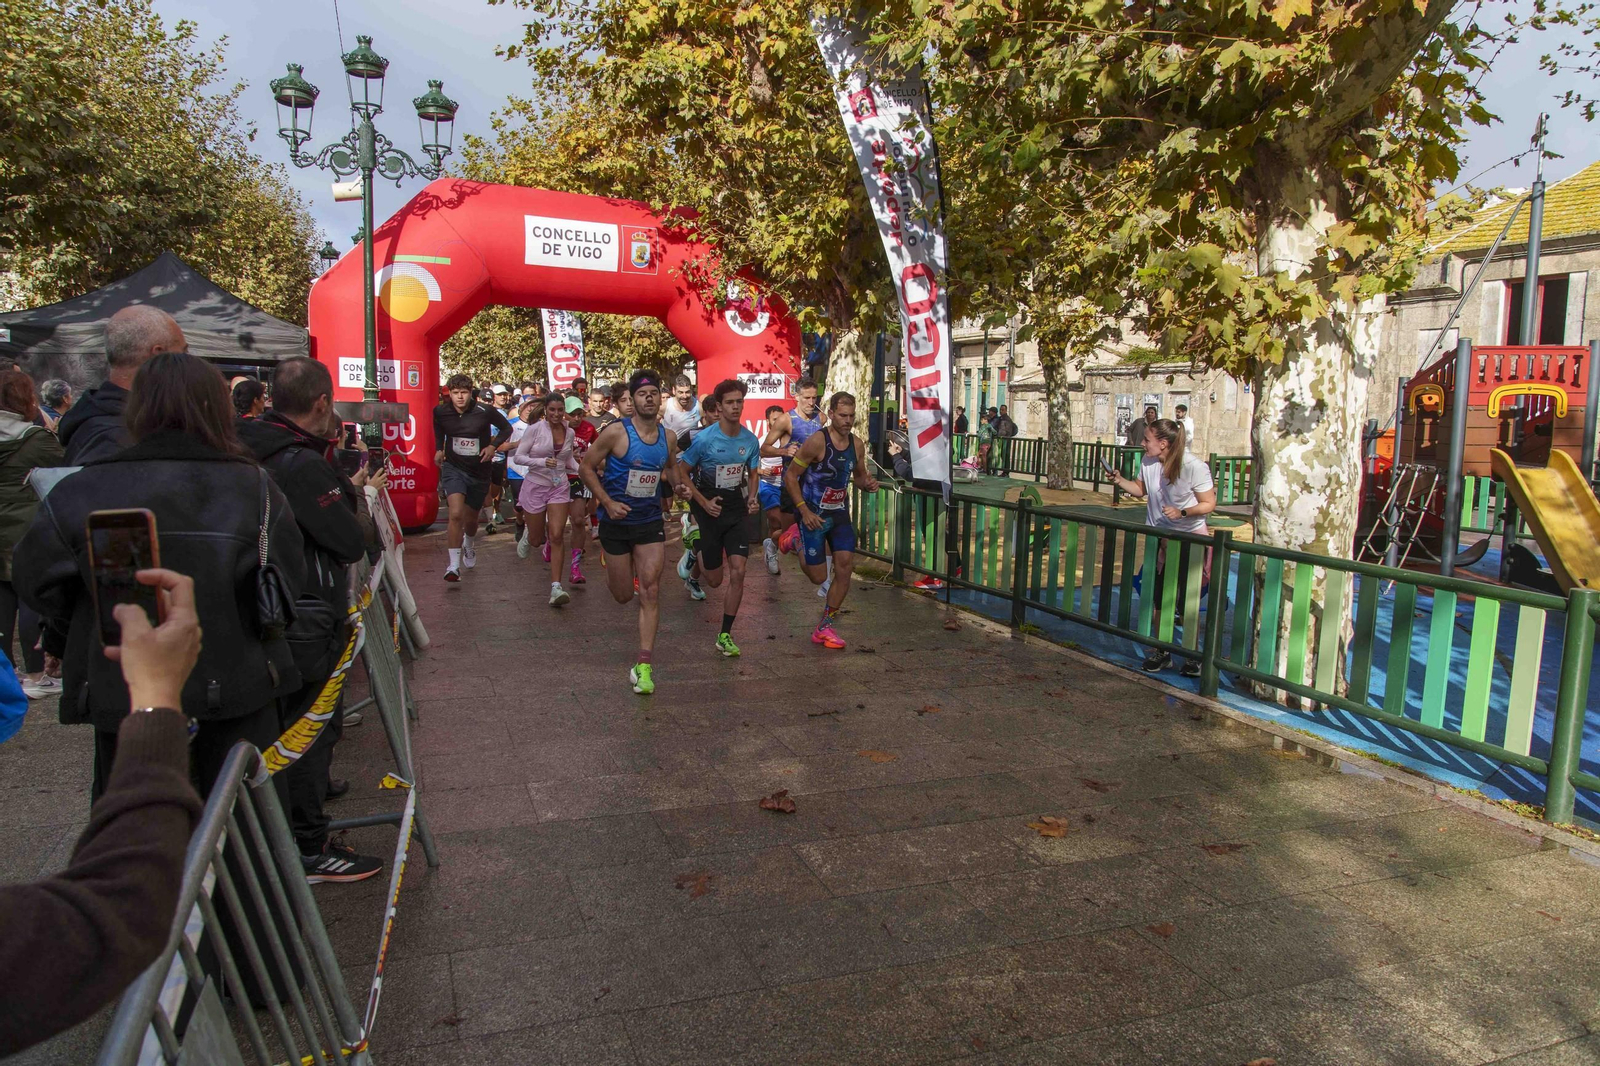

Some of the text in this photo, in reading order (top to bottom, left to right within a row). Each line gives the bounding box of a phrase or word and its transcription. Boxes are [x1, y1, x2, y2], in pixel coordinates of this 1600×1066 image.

[878, 88, 917, 100] CONCELLO
[883, 100, 893, 109] DE
[532, 226, 611, 244] CONCELLO
[542, 242, 602, 259] DE VIGO
[901, 263, 943, 449] VIGO
[551, 343, 582, 390] IGO
[349, 373, 362, 381] DE
[726, 466, 742, 476] 528
[640, 474, 657, 484] 608
